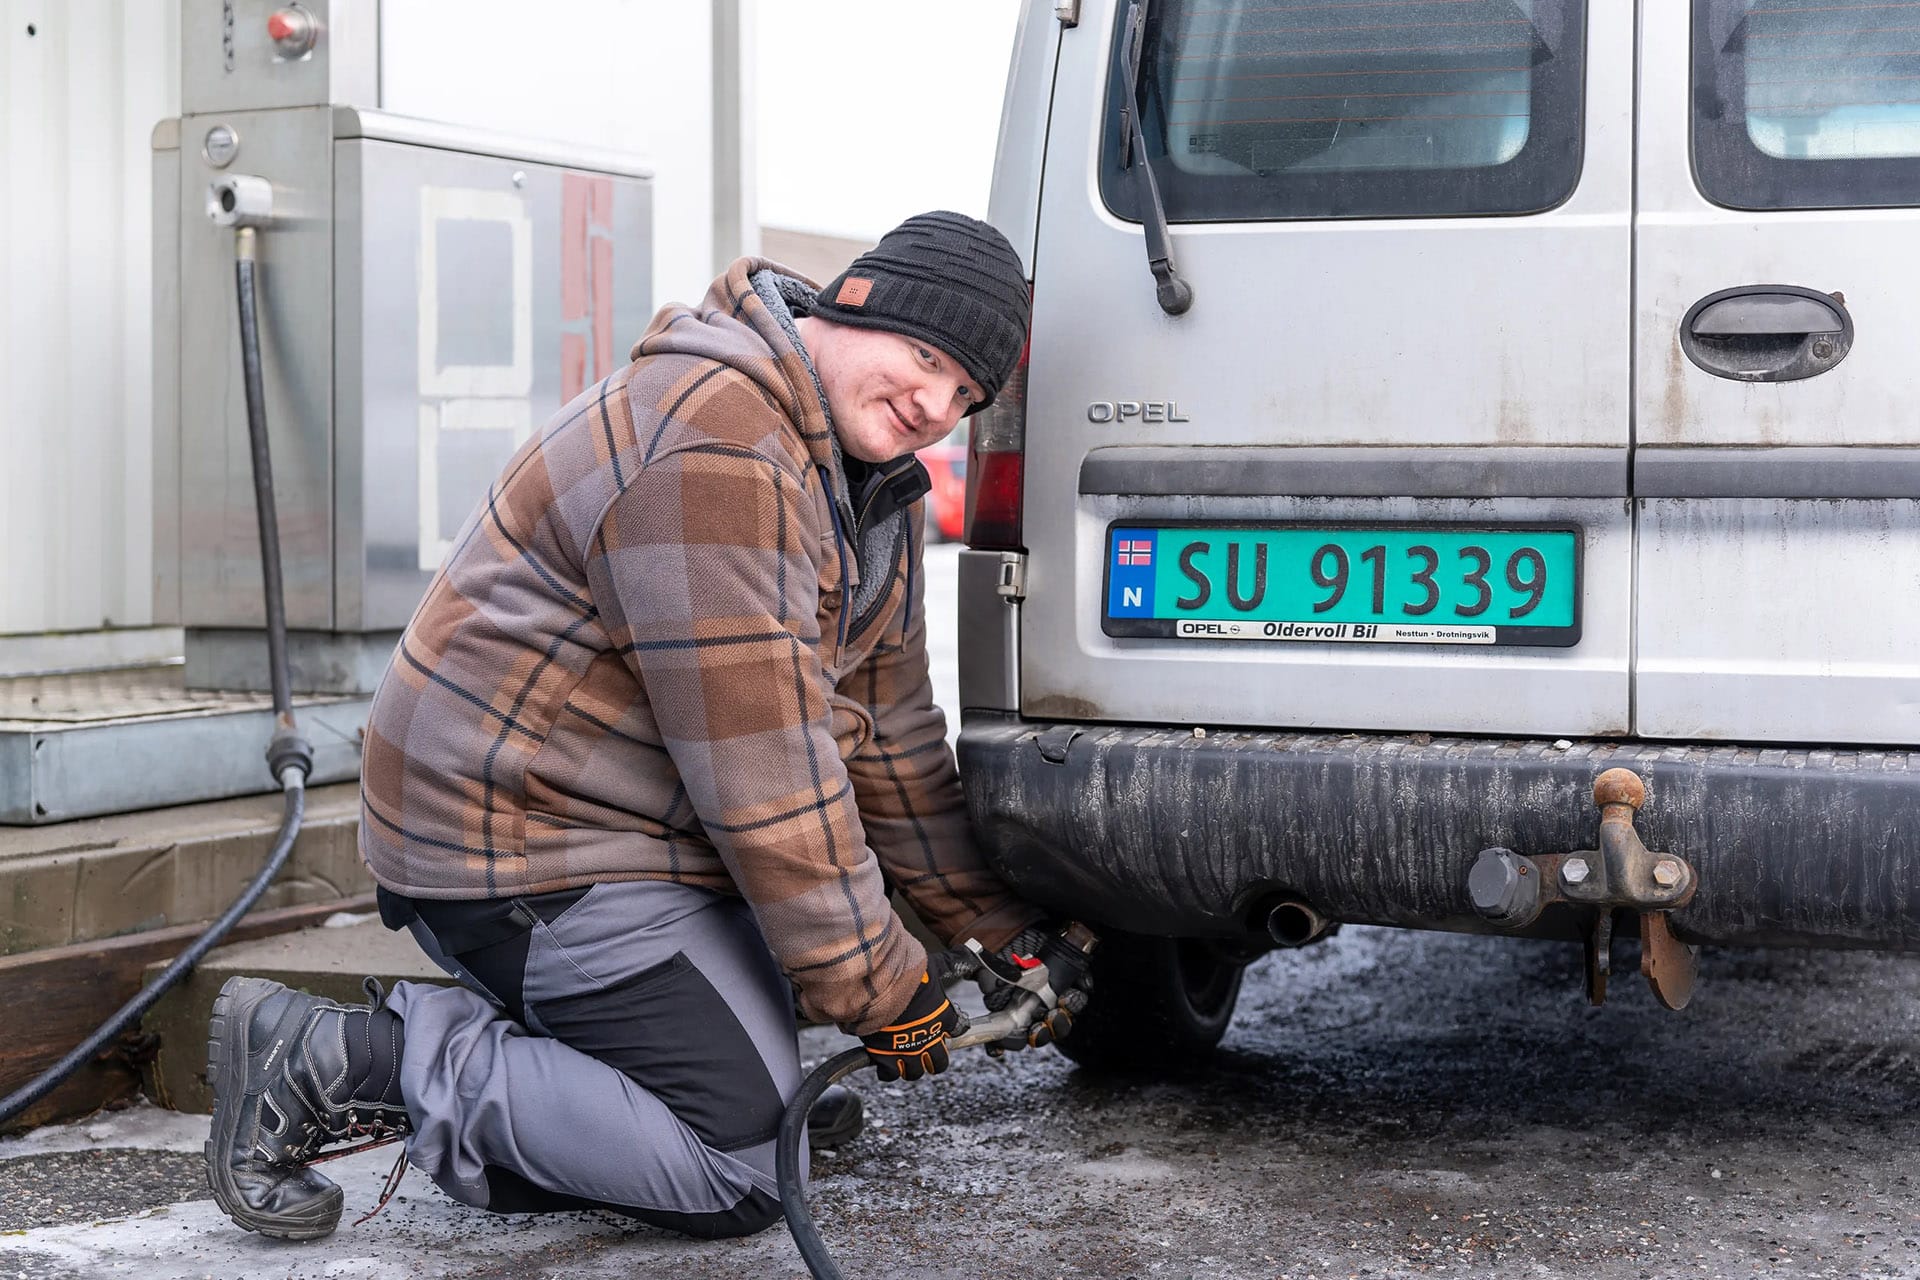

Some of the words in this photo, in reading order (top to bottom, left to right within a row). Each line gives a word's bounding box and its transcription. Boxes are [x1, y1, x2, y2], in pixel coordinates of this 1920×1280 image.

[1087, 401, 1190, 423] OPEL
[1176, 541, 1268, 612] SU
[1310, 543, 1547, 619] 91339
[1122, 586, 1143, 607] N
[1182, 623, 1227, 635] OPEL
[1263, 622, 1347, 638] Oldervoll
[1352, 624, 1378, 639] Bil
[1395, 629, 1429, 638] Nesttun
[1436, 630, 1490, 640] Drotningsvik
